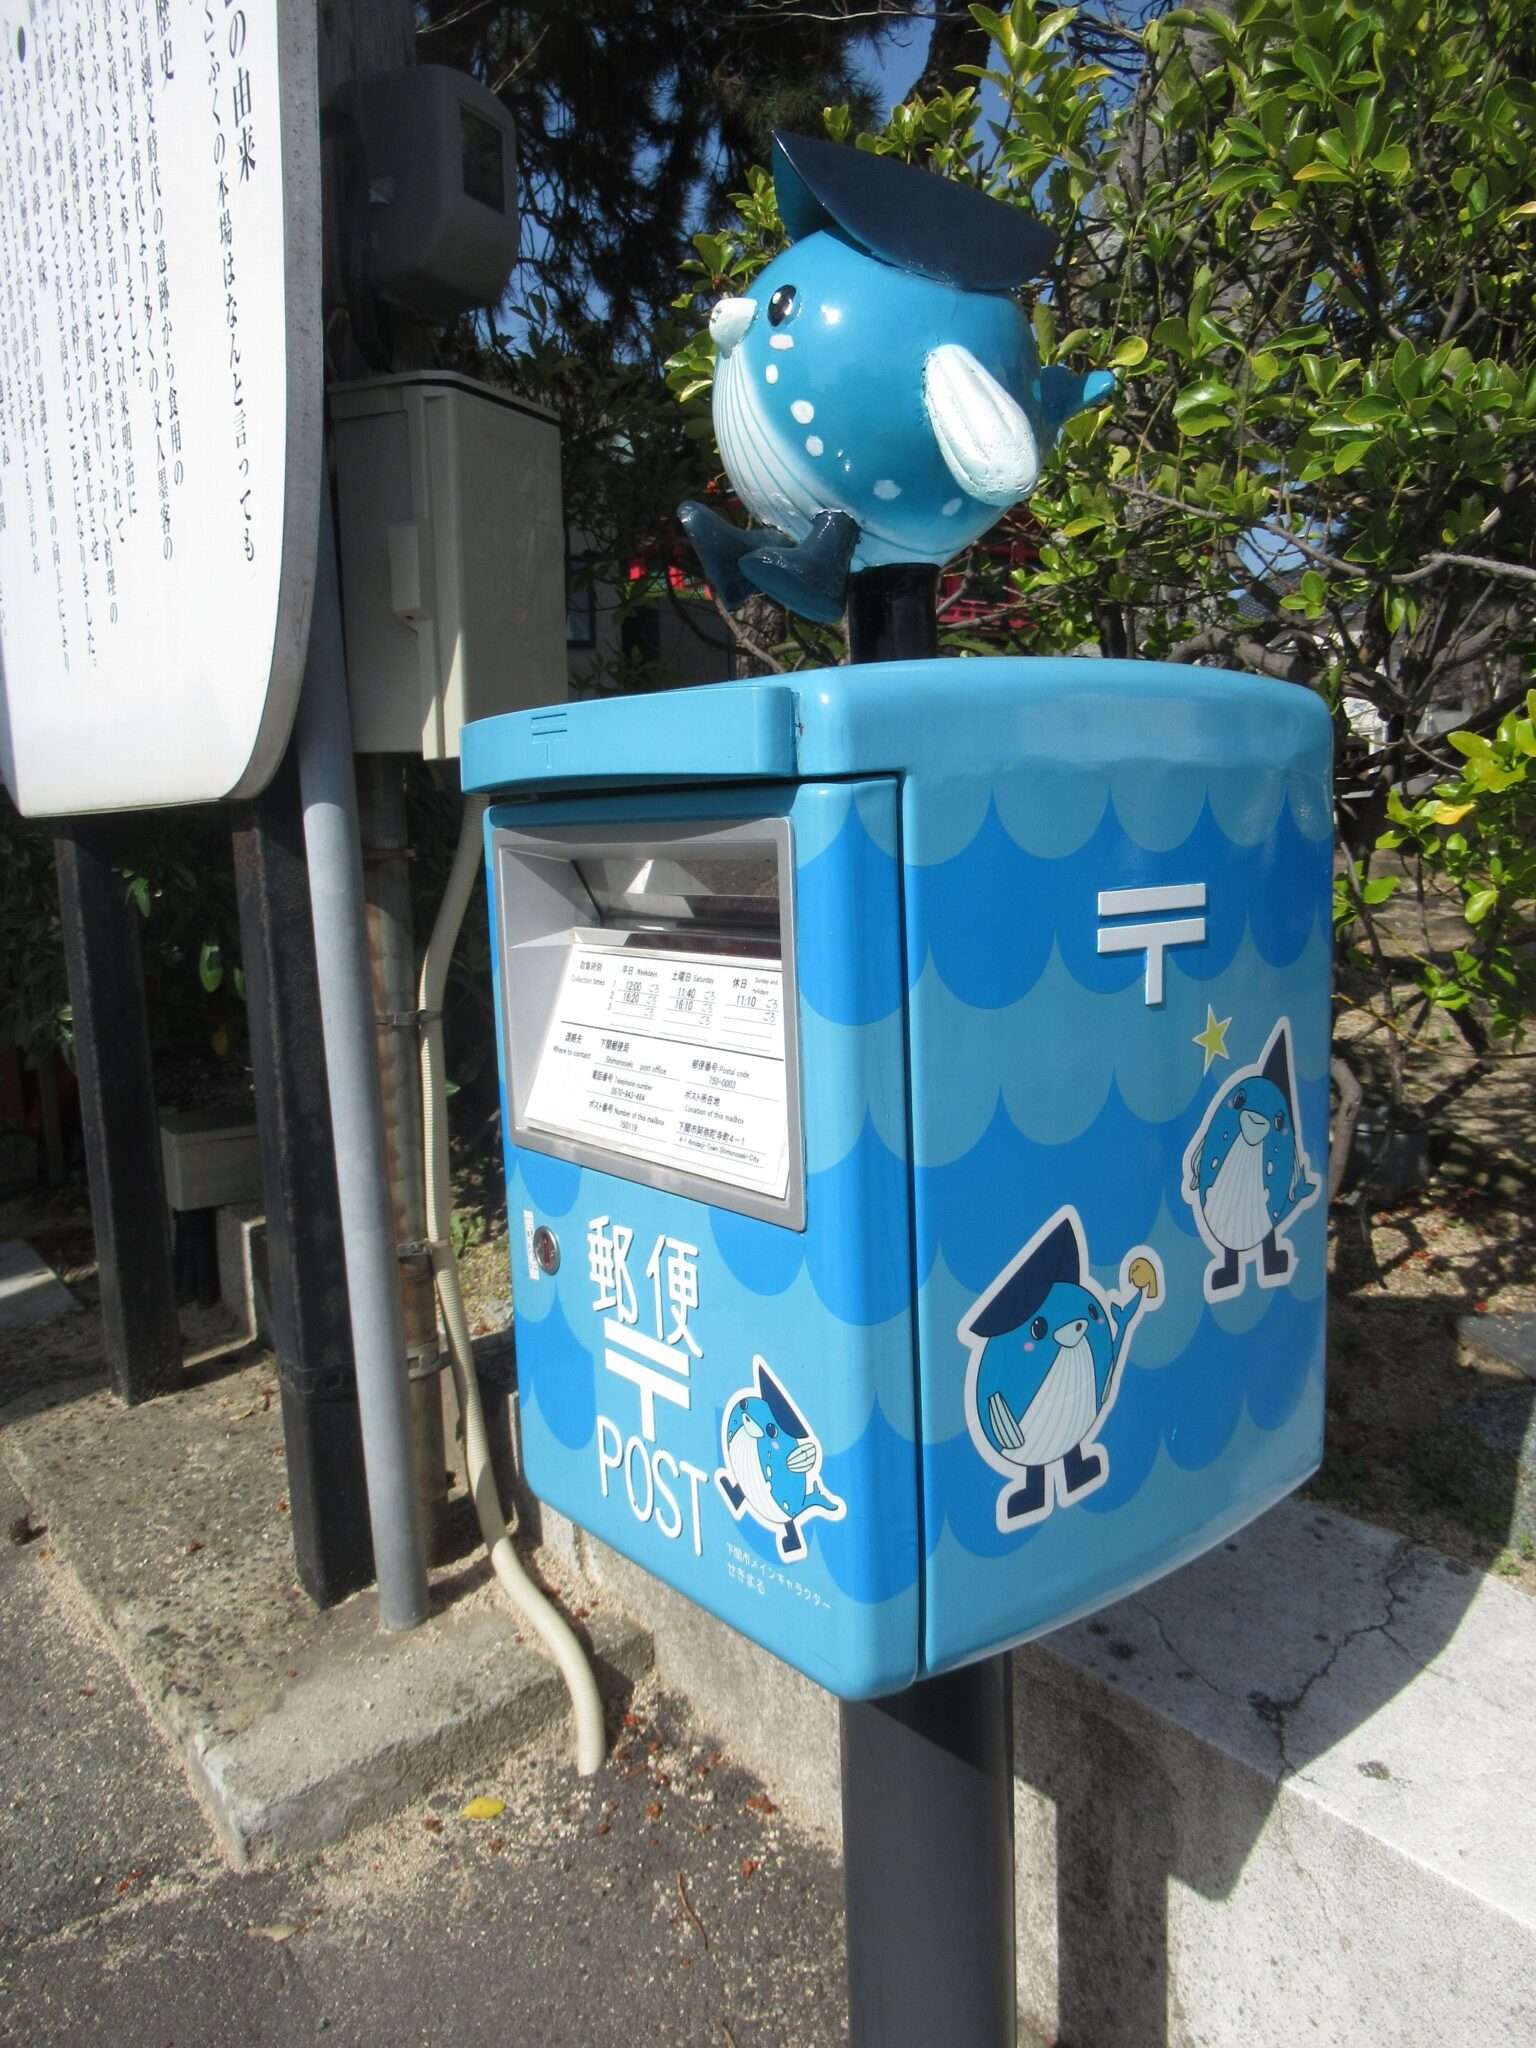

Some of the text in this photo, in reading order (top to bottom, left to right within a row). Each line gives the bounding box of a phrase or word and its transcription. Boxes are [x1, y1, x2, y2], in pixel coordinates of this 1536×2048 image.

[224, 0, 256, 186] の由来
[672, 971, 692, 982] 土曜日
[732, 977, 748, 989] 休日
[736, 995, 756, 1008] 11:10
[692, 1059, 718, 1073] 郵便番号
[588, 1216, 704, 1358] 郵便
[596, 1415, 709, 1558] POST
